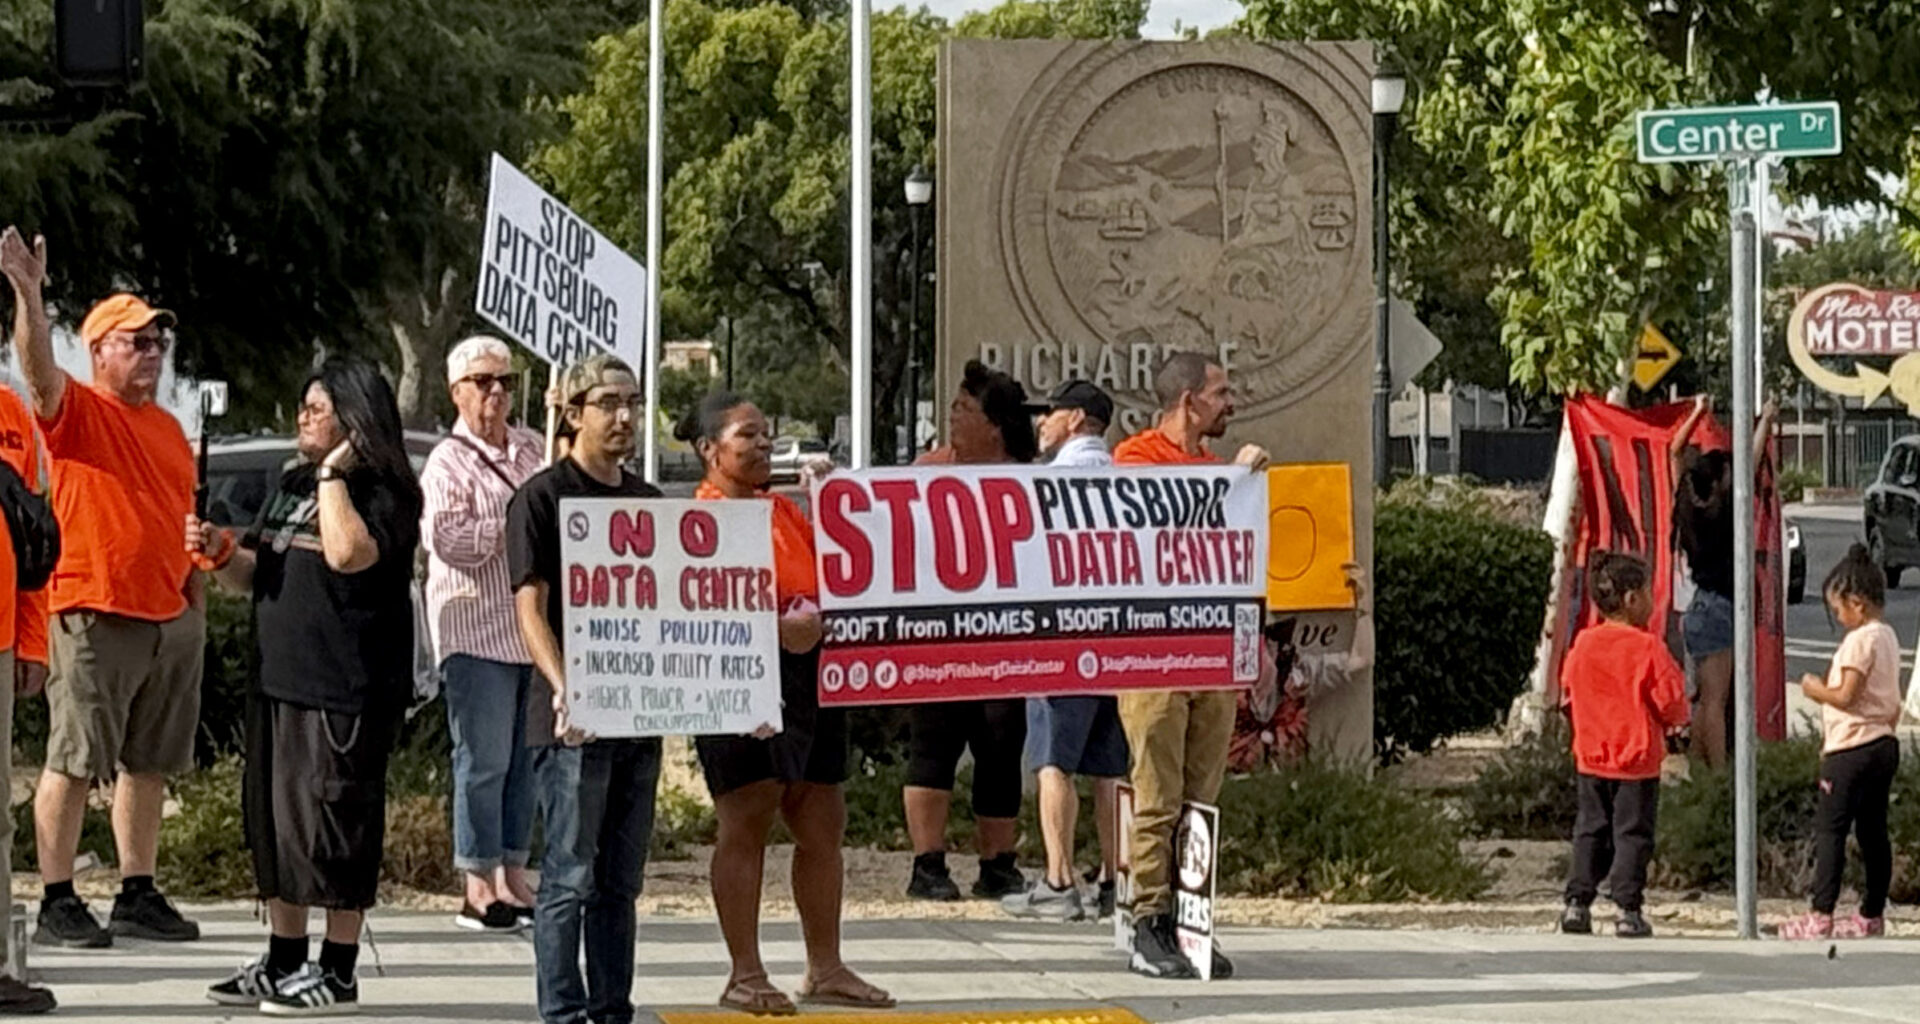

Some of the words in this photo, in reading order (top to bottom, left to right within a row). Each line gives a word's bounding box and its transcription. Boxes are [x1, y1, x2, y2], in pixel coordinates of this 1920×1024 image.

[1650, 117, 1784, 154] Center
[1801, 112, 1827, 132] Dr
[540, 198, 595, 273] STOP
[495, 213, 618, 349] PITTSBURG
[481, 261, 537, 348] DATA
[1816, 295, 1881, 319] Mar
[1806, 320, 1920, 351] MOTE
[980, 342, 1178, 391] RICHAR
[818, 476, 1035, 598] STOP
[1033, 477, 1230, 530] PITTSBURG
[1046, 530, 1144, 588] DATA
[1156, 529, 1254, 587] CENTER
[569, 562, 658, 610] DATA
[680, 565, 775, 612] CENTER
[589, 618, 641, 643] NOISE
[659, 619, 752, 648] POLLUTION
[897, 615, 947, 640] from
[954, 609, 1036, 637] HOMES
[1057, 605, 1121, 633] 1500FT
[1127, 606, 1165, 630] from
[586, 650, 655, 677] INCREASED
[662, 653, 713, 680] UTILITY
[721, 654, 766, 681] RATES
[705, 688, 751, 715] WATER
